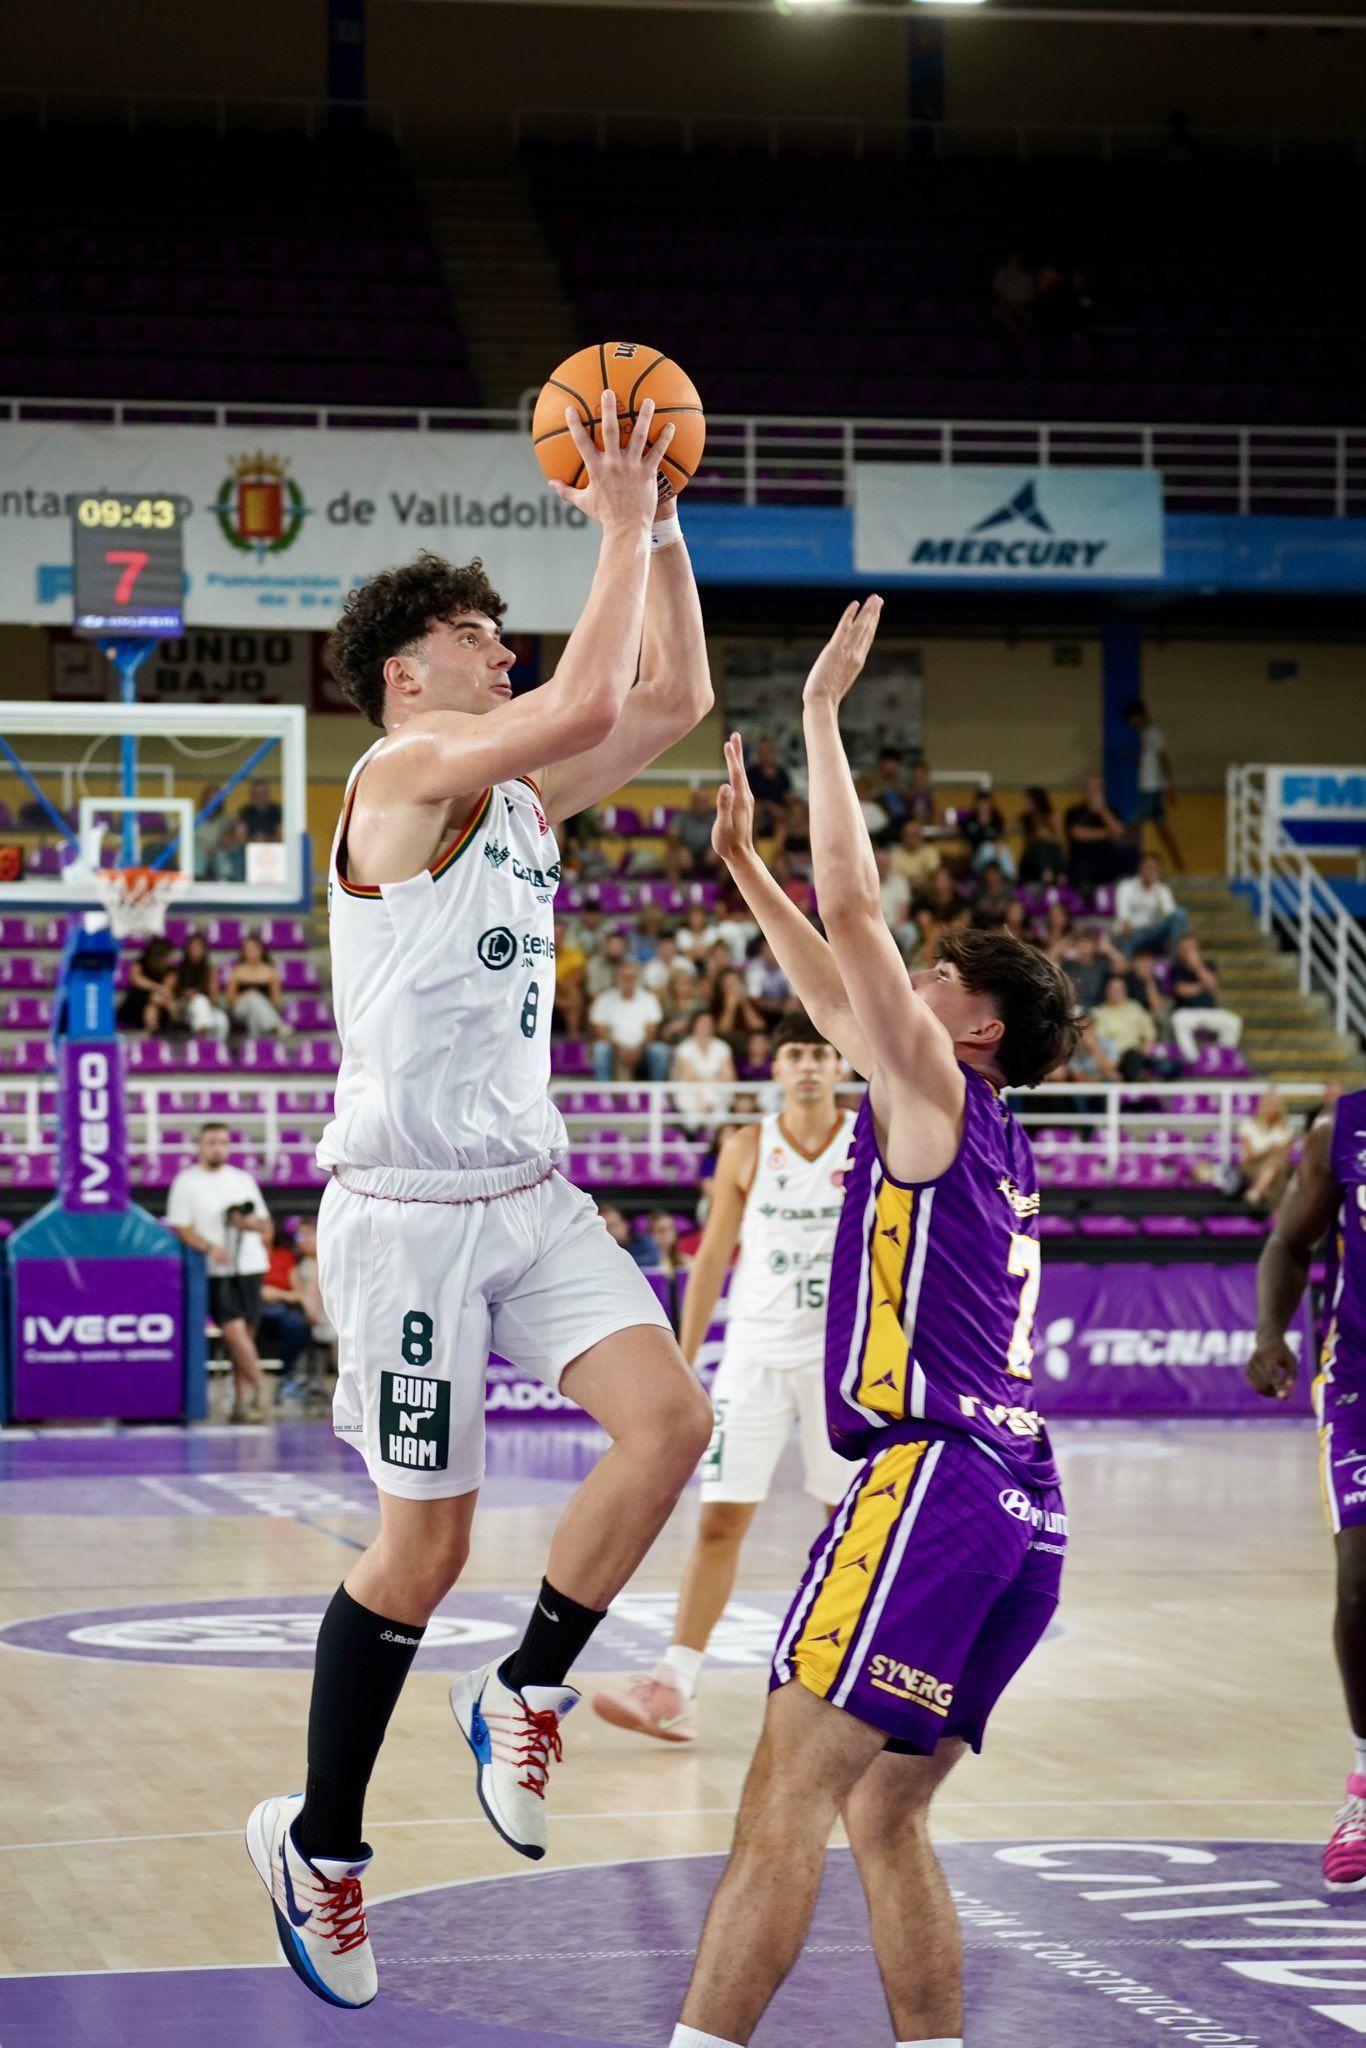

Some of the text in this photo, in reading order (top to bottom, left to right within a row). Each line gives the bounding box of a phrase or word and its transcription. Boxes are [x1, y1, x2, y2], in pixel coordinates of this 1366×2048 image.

[78, 498, 176, 529] 09:43
[326, 490, 376, 525] de
[910, 536, 1110, 567] MERCURY
[105, 550, 149, 605] 7
[1282, 773, 1366, 808] FM
[520, 981, 539, 1039] 8
[79, 1052, 111, 1204] IVECO
[795, 1278, 825, 1309] 15
[23, 1313, 175, 1345] IVECO
[401, 1310, 434, 1367] 8
[392, 1375, 438, 1409] BUN
[389, 1434, 437, 1467] HAM
[950, 1889, 1023, 1927] CIÓN
[993, 1930, 1045, 1939] &
